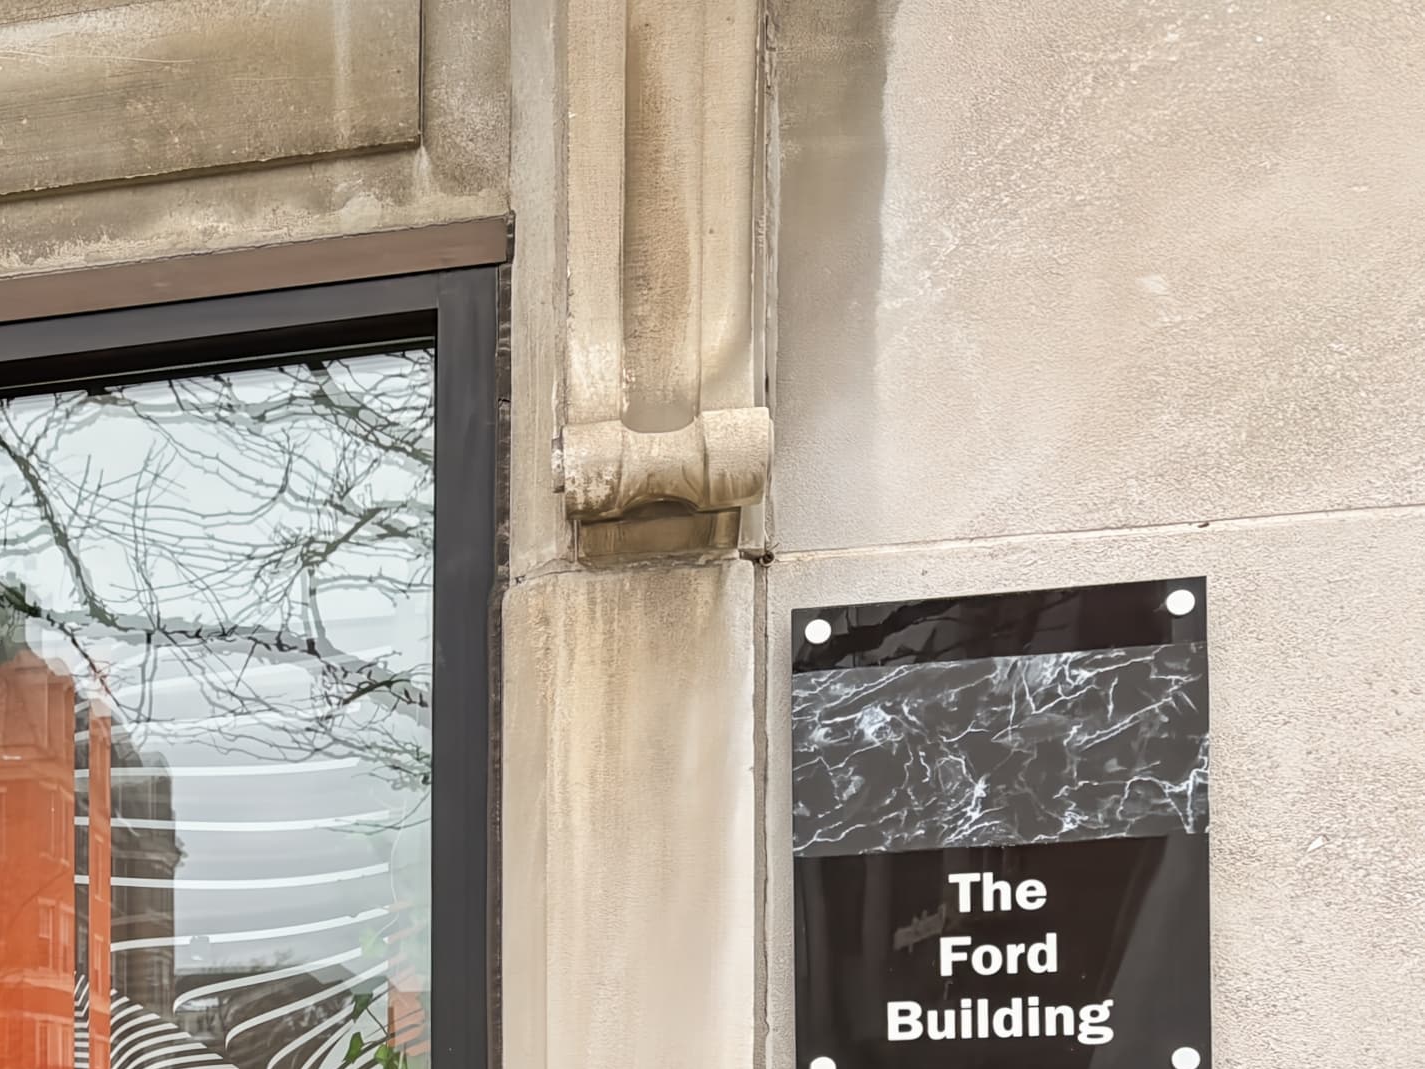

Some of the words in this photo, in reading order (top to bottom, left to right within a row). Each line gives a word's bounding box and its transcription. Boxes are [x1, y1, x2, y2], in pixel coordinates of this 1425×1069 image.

[948, 872, 1048, 913] The
[940, 932, 1058, 977] Ford
[887, 996, 1115, 1045] Building
